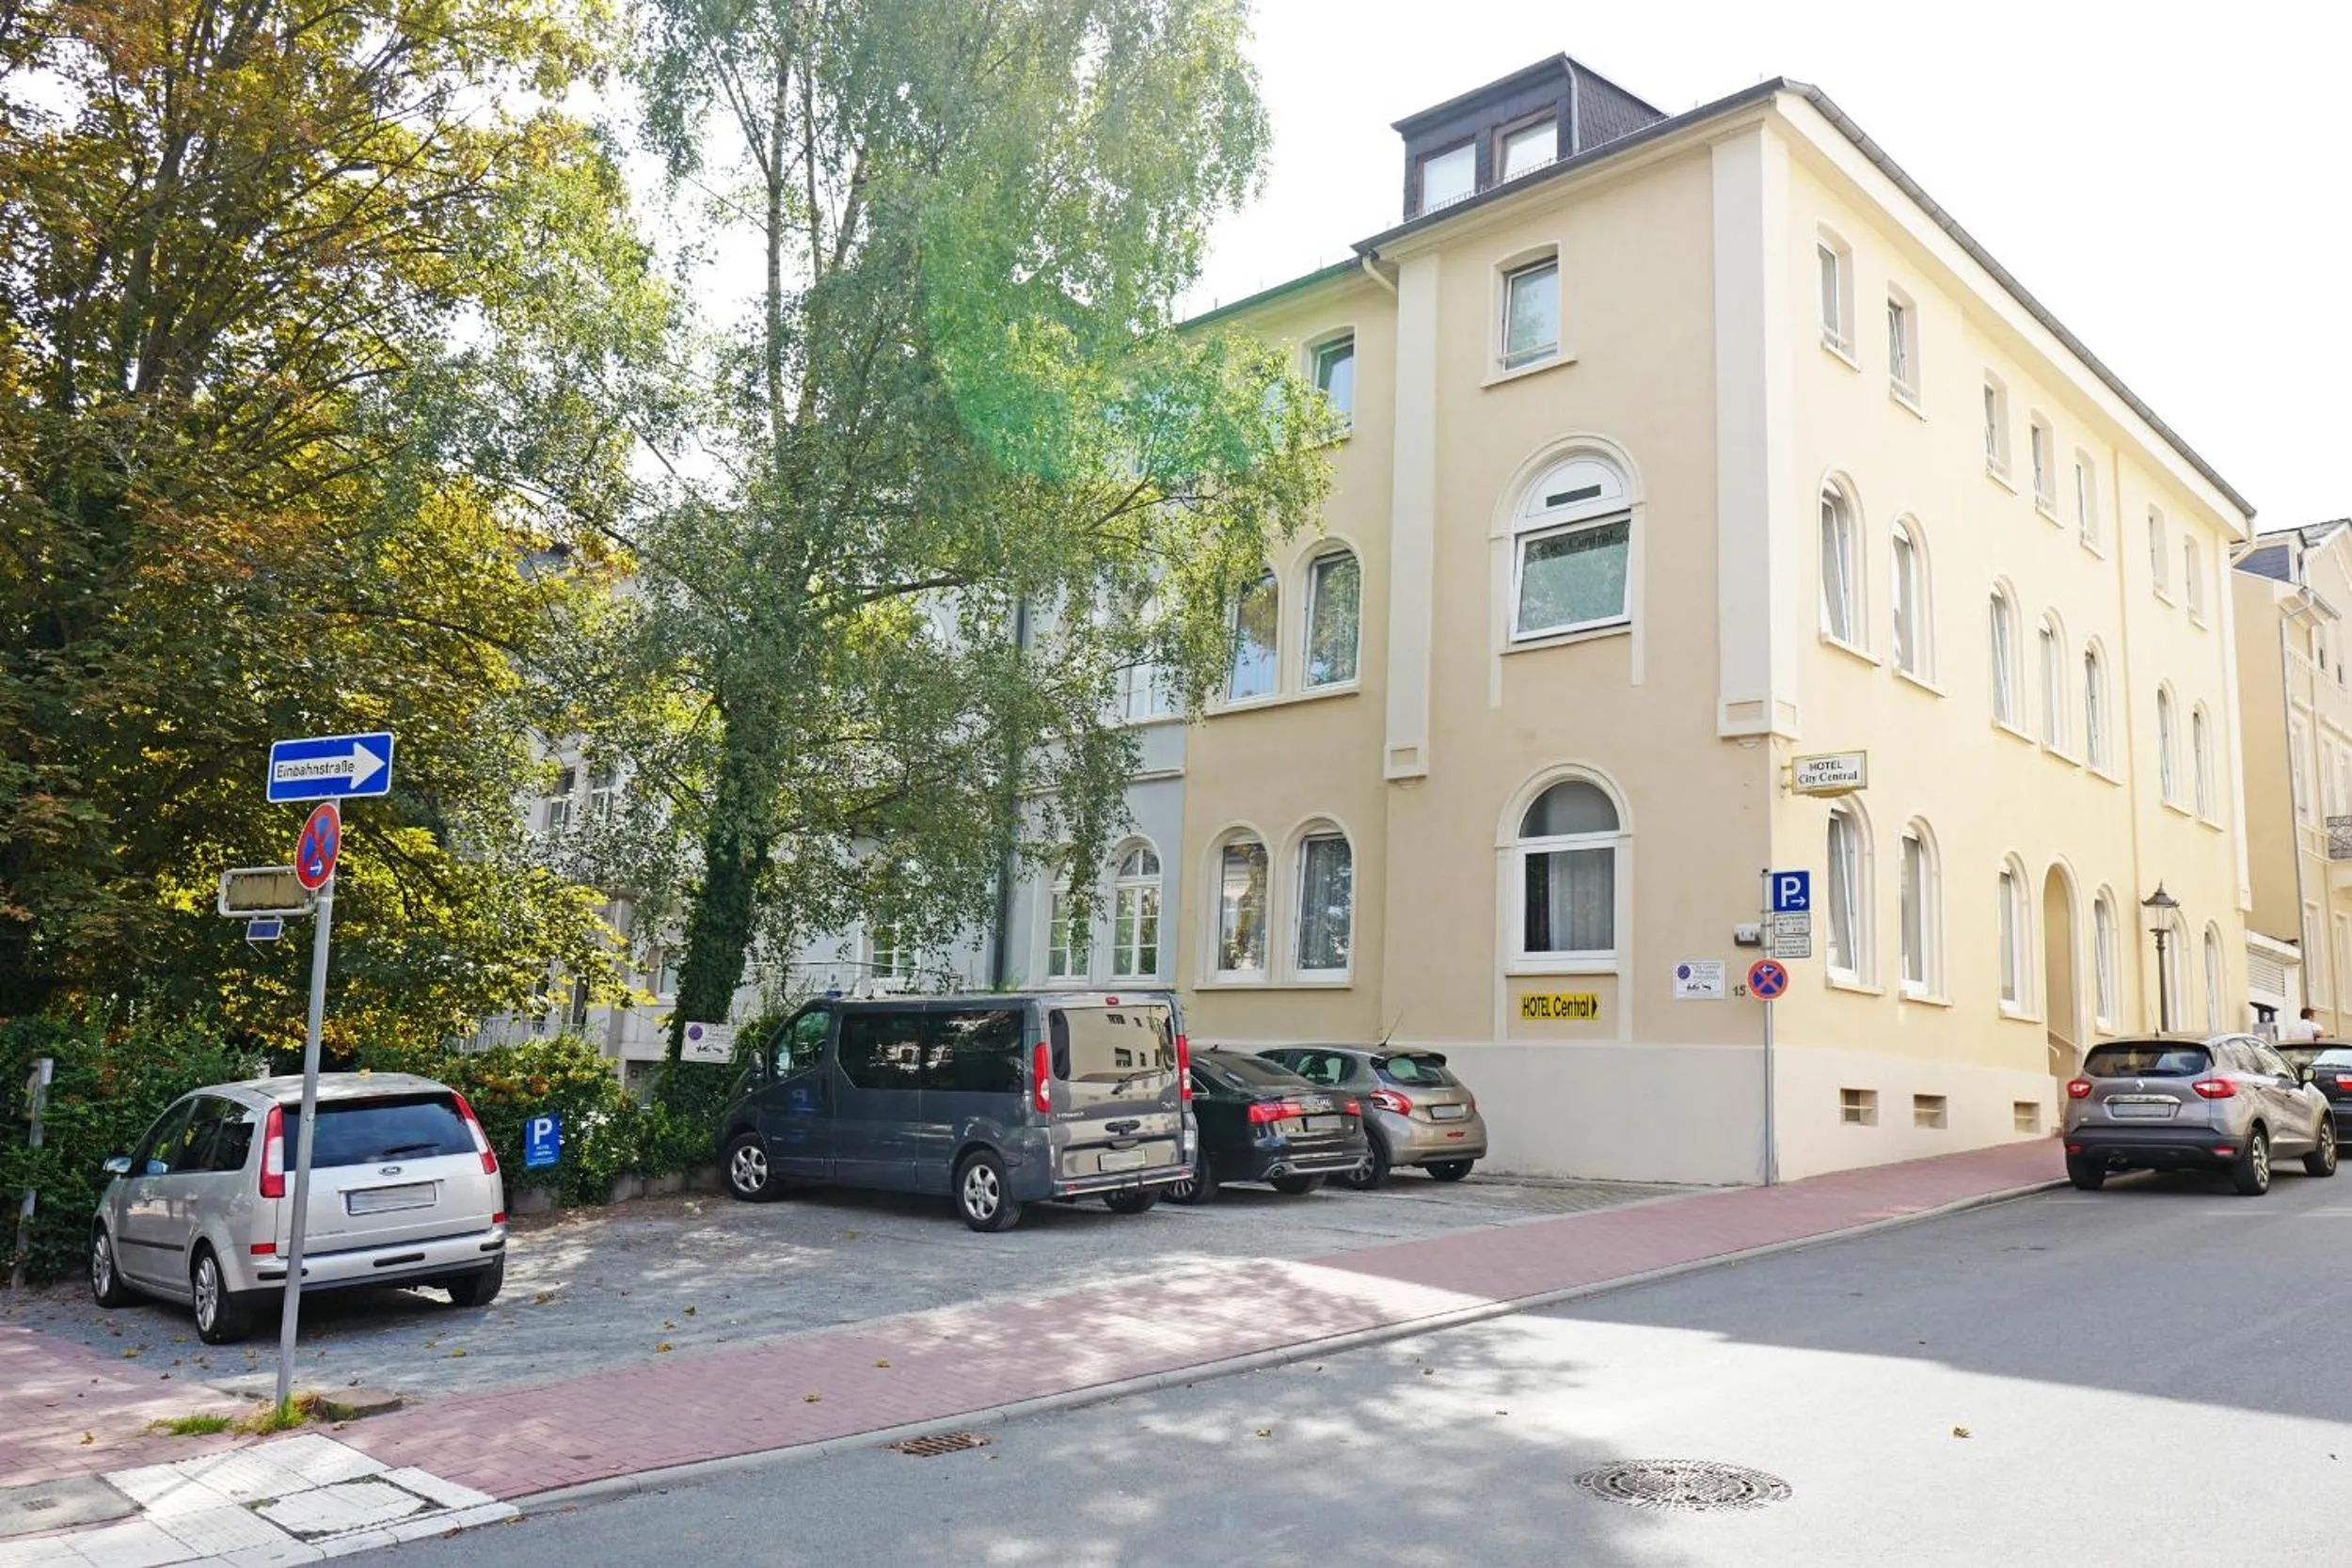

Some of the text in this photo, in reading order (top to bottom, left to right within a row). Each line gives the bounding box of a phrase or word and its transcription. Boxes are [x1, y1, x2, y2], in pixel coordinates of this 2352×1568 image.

[277, 760, 355, 779] Einbahnstraße
[1809, 760, 1843, 771] HOTEL
[1798, 770, 1858, 785] City Central
[1781, 876, 1801, 908] P
[1732, 984, 1746, 997] 15
[1522, 995, 1590, 1017] HOTEL Central
[533, 1117, 553, 1145] P
